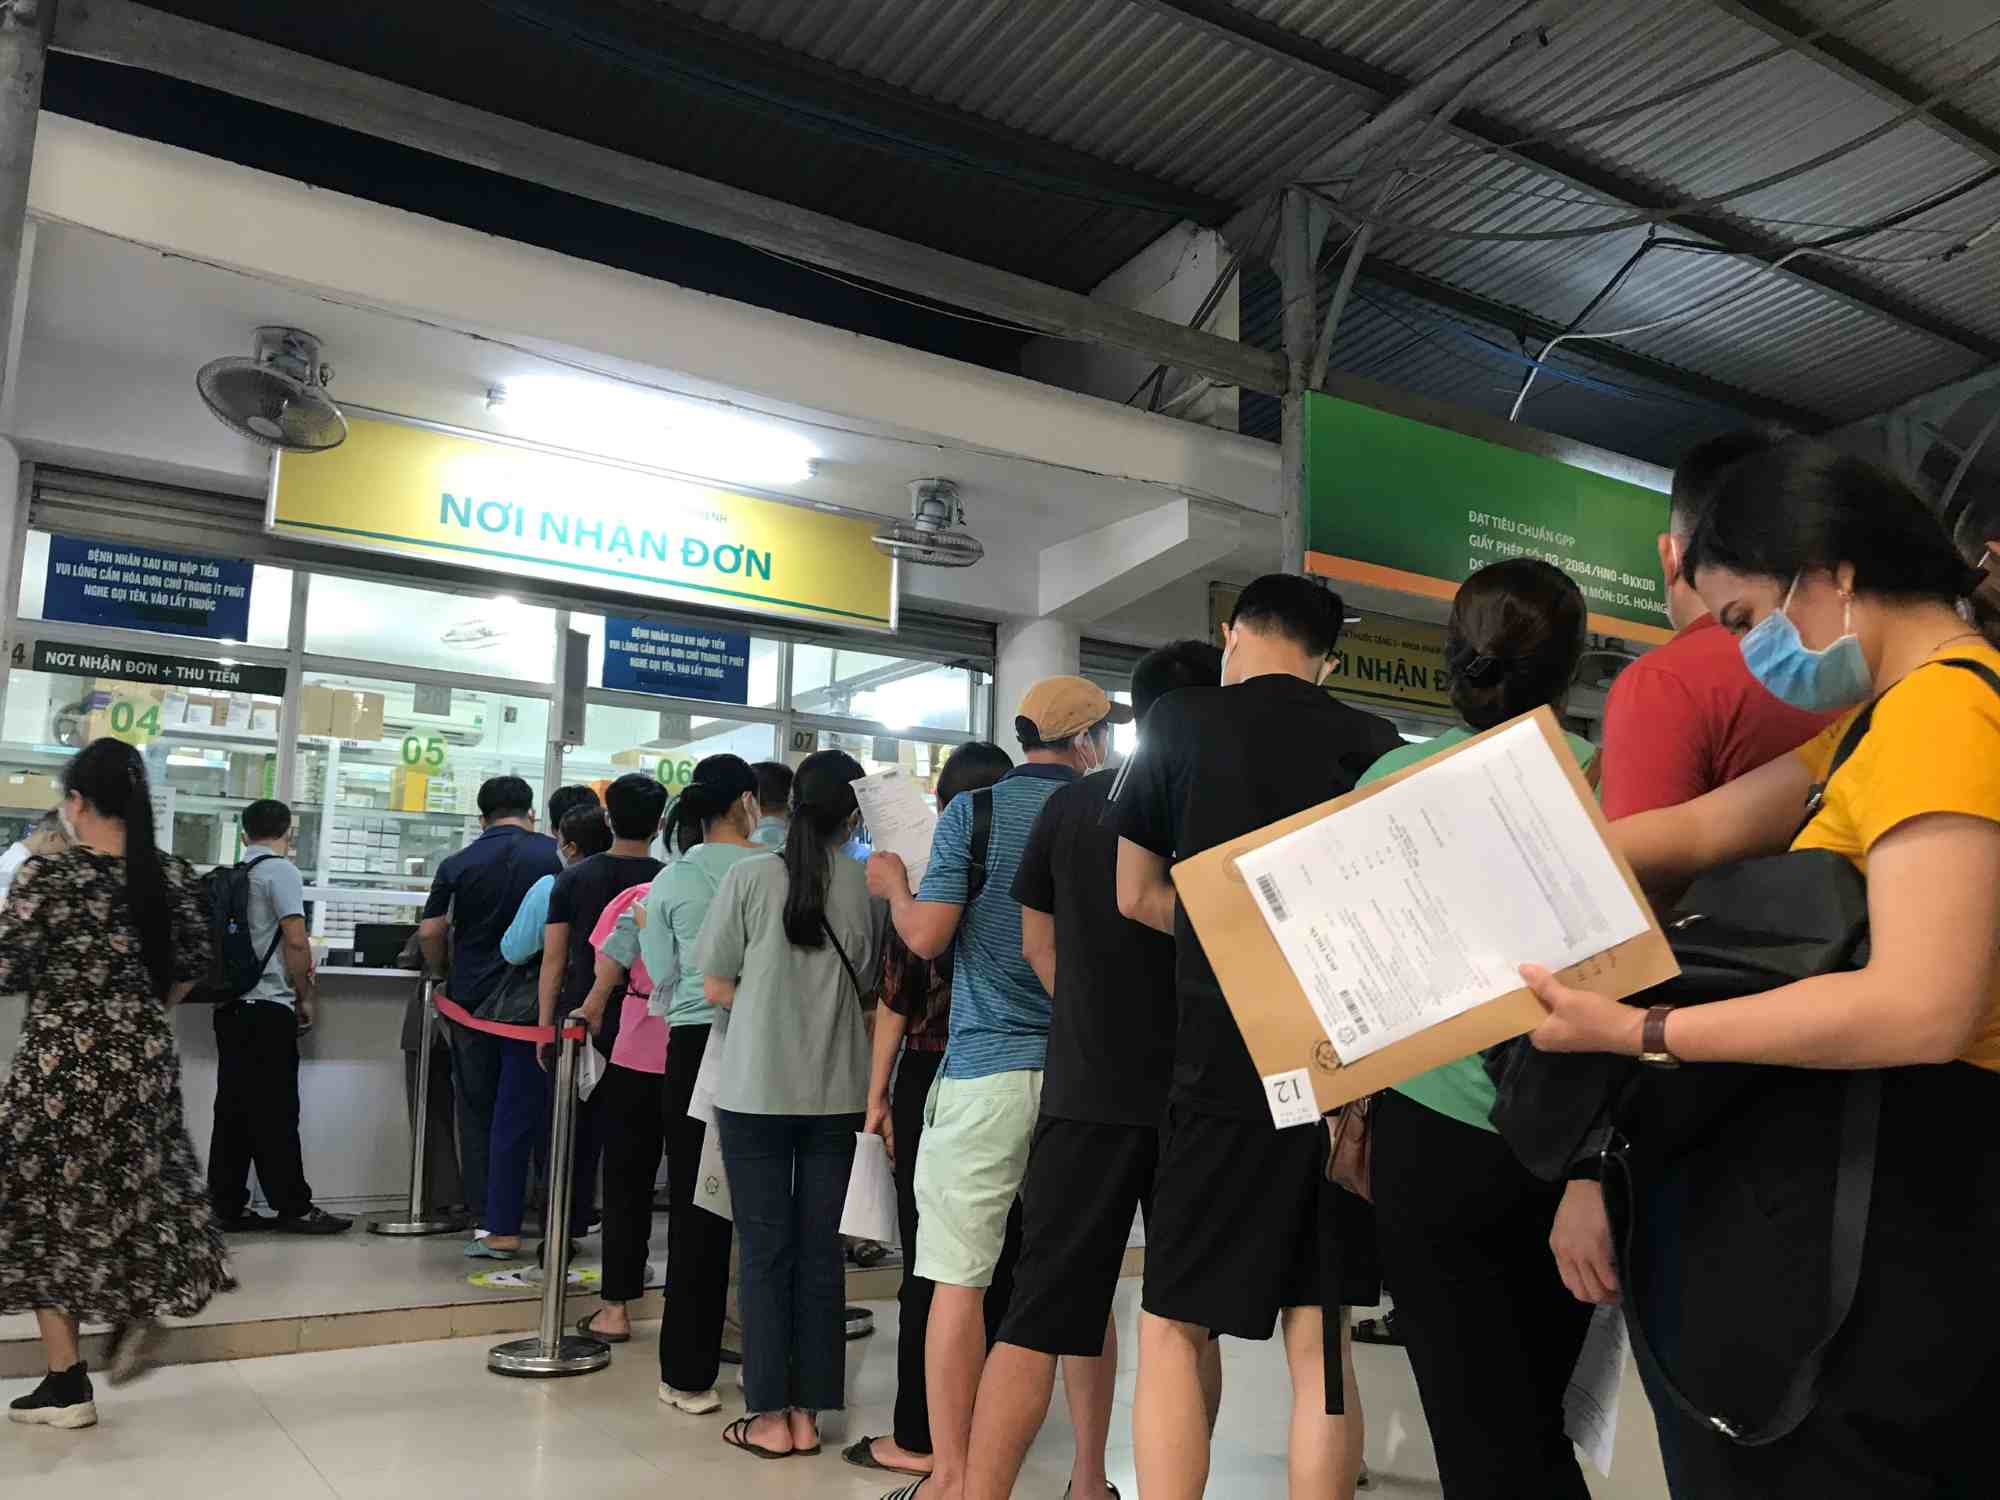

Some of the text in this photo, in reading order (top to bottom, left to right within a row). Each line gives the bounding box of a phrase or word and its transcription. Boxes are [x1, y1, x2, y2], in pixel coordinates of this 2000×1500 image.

[1469, 510, 1489, 528] ĐẠT
[440, 493, 772, 581] NƠI NHẬN ĐƠN
[88, 549, 112, 563] BỆNH
[115, 552, 140, 565] NHÂN
[143, 557, 160, 569] SAU
[162, 558, 178, 571] KHI
[200, 562, 219, 577] TIỀN
[55, 562, 71, 575] VUI
[73, 562, 97, 578] LÒNG
[99, 566, 120, 582] CẦM
[142, 574, 162, 588] ĐƠN
[183, 579, 212, 594] TRONG
[214, 582, 222, 595] ÍT
[224, 584, 245, 598] PHÚT
[84, 584, 109, 598] NGHE
[111, 587, 127, 601] GỌI
[151, 591, 168, 605] VÀO
[170, 594, 187, 608] LẤY
[188, 597, 216, 611] THUỐC
[45, 651, 240, 684] NƠI NHẬN ĐƠN + THU TIỀN
[1357, 656, 1427, 692] NHẬN
[111, 702, 161, 736] 04
[402, 736, 444, 765] 05
[794, 732, 813, 749] 07
[657, 759, 692, 785] 06
[1274, 1079, 1300, 1103] 12
